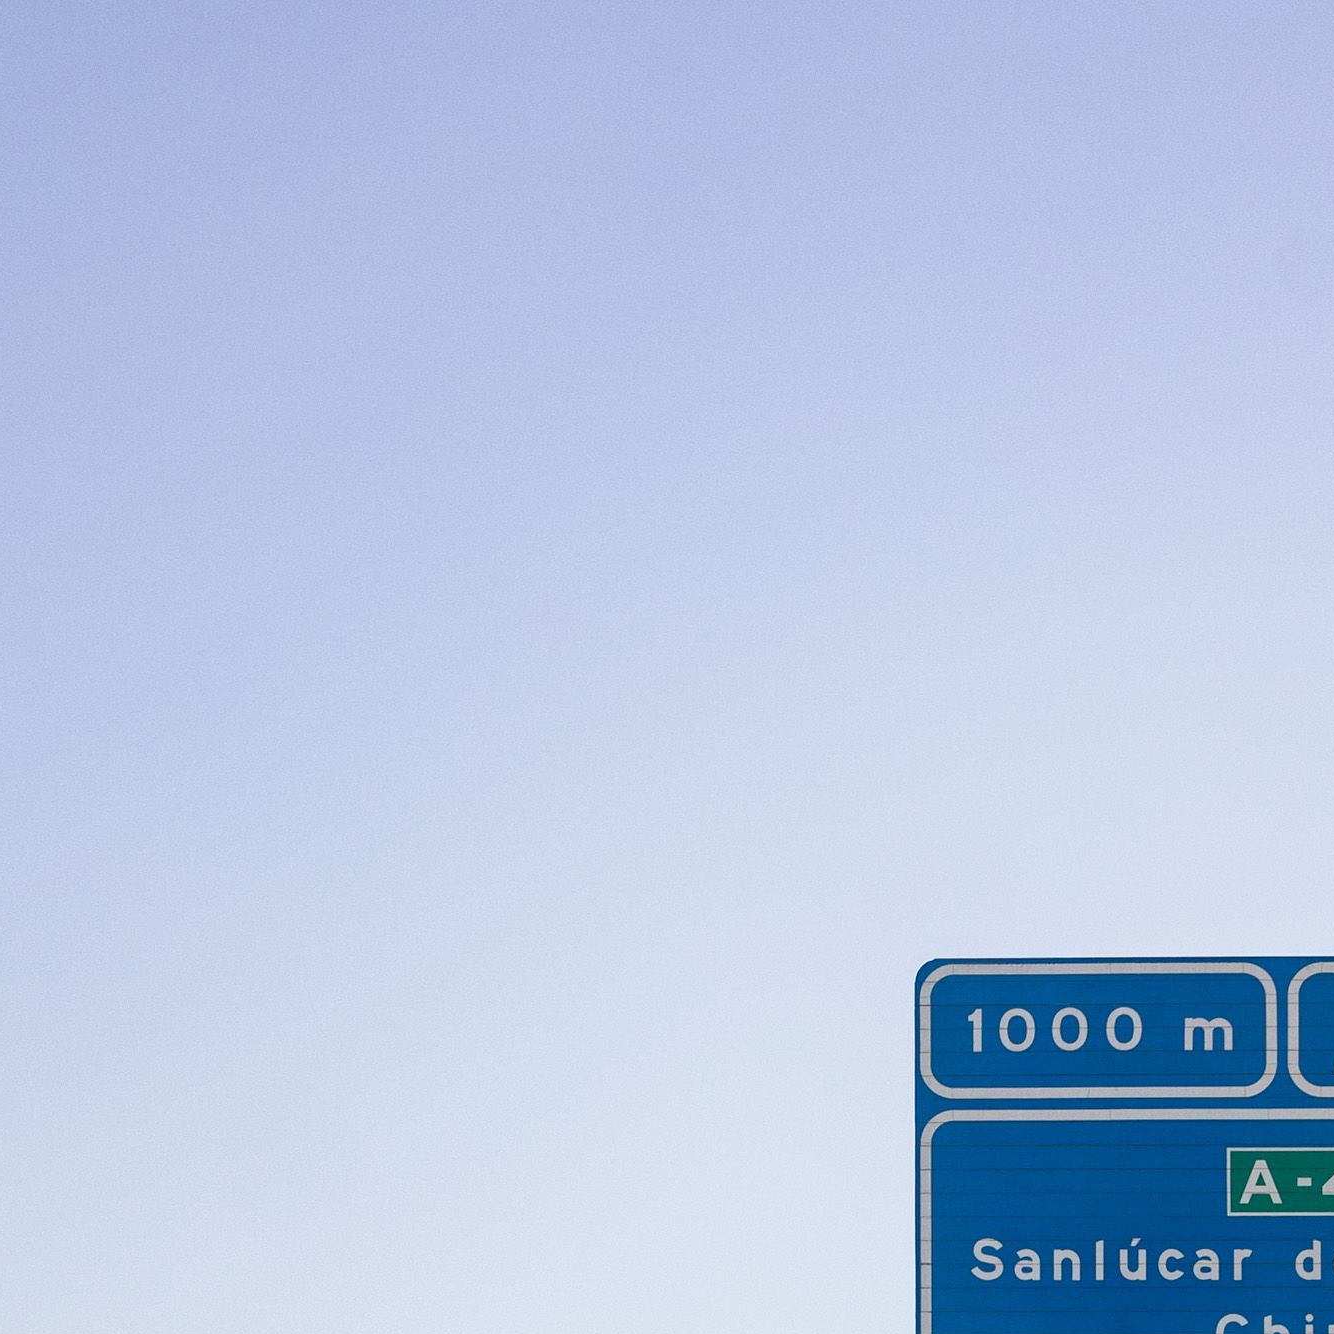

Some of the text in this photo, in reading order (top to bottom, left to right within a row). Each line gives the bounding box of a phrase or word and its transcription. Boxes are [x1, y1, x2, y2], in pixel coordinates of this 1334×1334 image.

[967, 1006, 1235, 1053] 1000 m
[971, 1237, 1253, 1282] Sanlúcar
